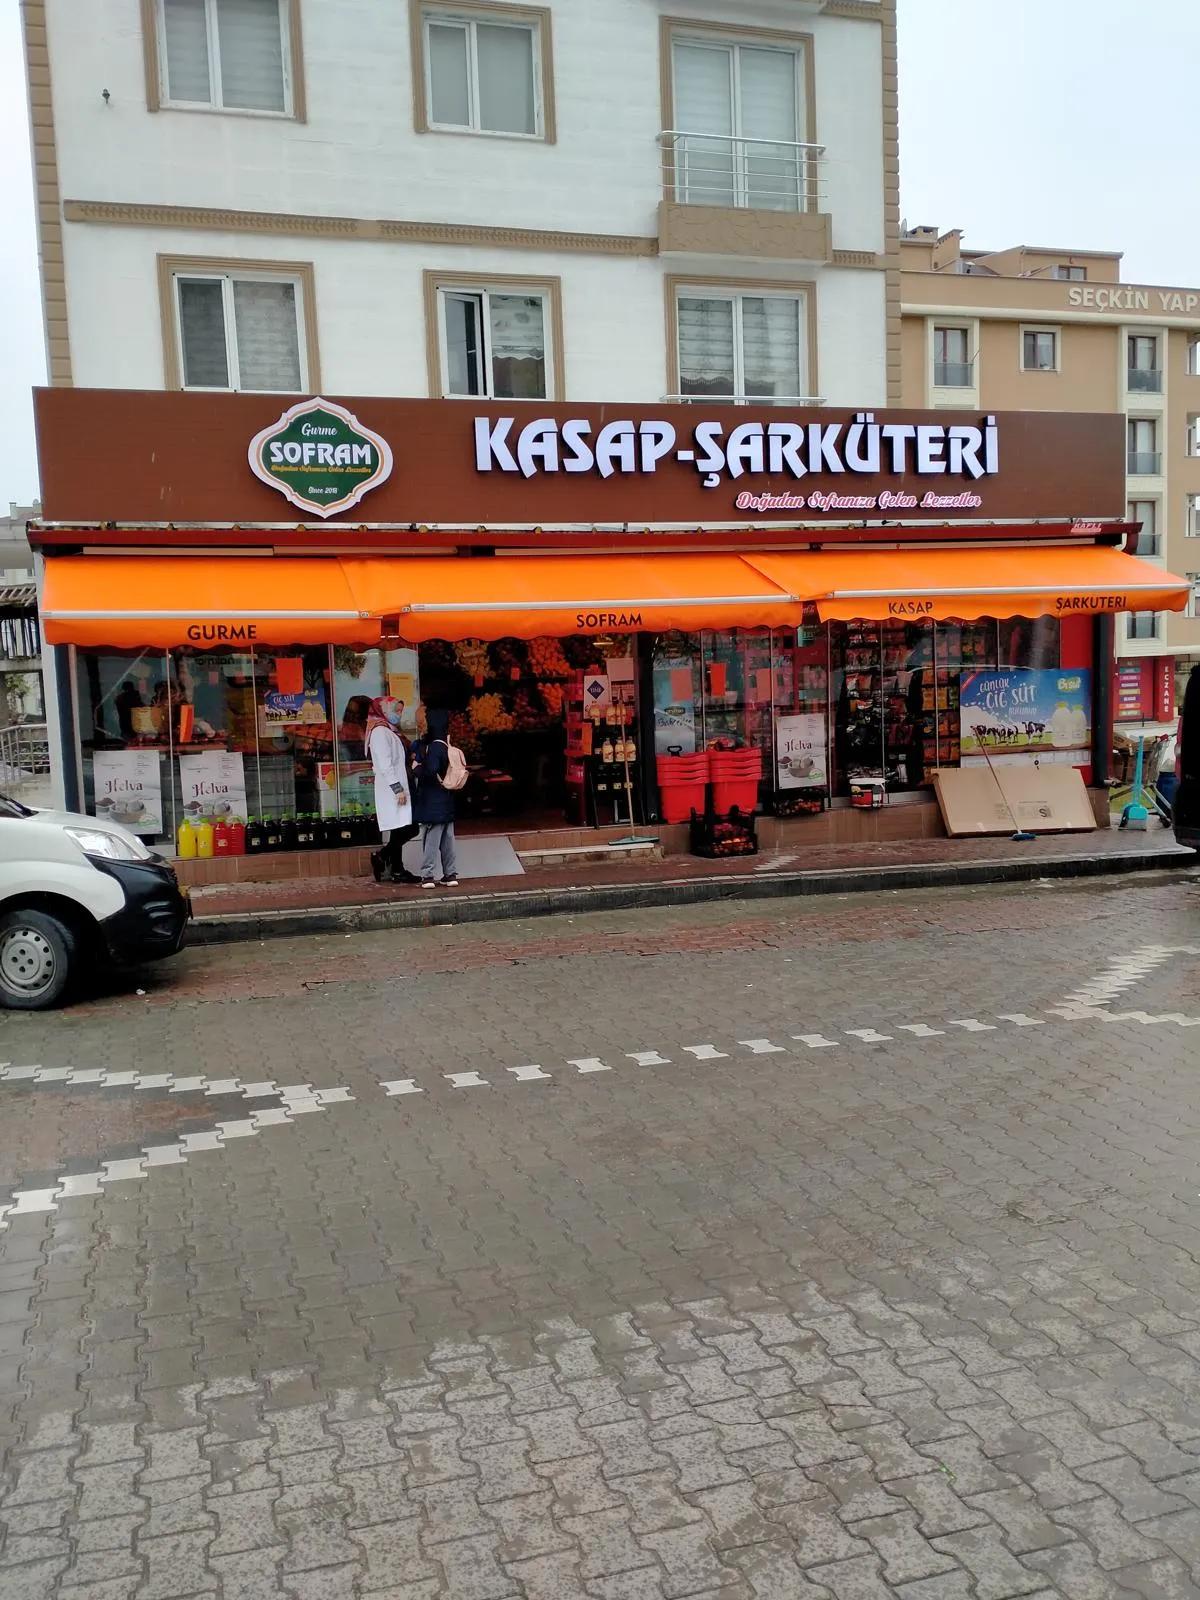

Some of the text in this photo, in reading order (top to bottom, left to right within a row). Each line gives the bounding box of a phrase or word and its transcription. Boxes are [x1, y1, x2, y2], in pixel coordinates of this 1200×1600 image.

[1068, 285, 1149, 312] SEÇKİN
[301, 422, 338, 436] Gurme
[270, 442, 371, 465] SOFRAM
[474, 412, 998, 488] KASAP-ŞARKÜTERİ
[736, 491, 982, 512] Doğadan Sofranıza Gelen Lezzetler
[888, 602, 934, 615] KASAP
[576, 613, 643, 628] SOFRAM
[187, 624, 257, 641] GURME
[785, 739, 812, 753] Helva
[105, 778, 143, 794] Helva
[192, 781, 229, 797] Helva
